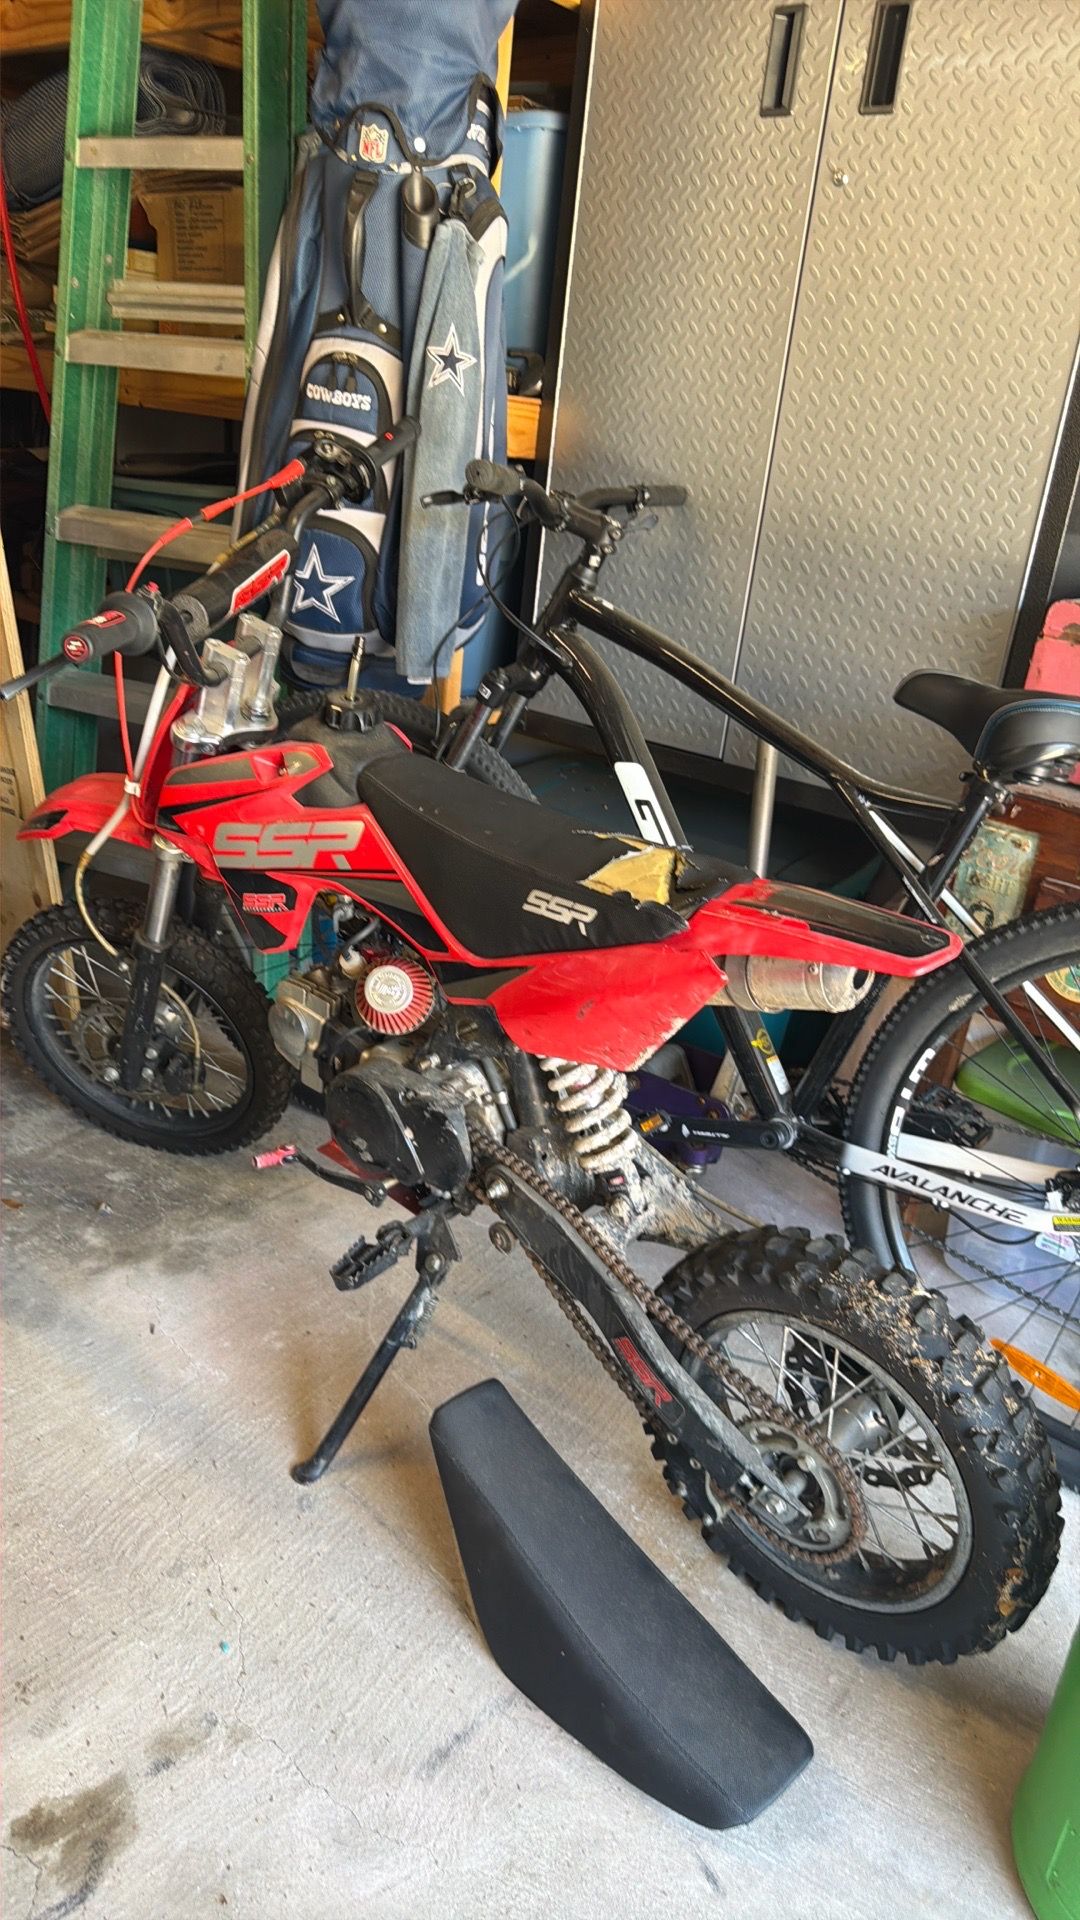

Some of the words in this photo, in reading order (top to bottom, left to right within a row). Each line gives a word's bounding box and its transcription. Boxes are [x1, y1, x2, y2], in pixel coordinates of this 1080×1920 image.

[362, 138, 383, 158] NFL
[306, 382, 372, 412] COWBOYS
[213, 820, 366, 871] SSR
[243, 892, 289, 912] SSR
[522, 888, 598, 937] SSR
[870, 1164, 1028, 1225] AVALANCHE
